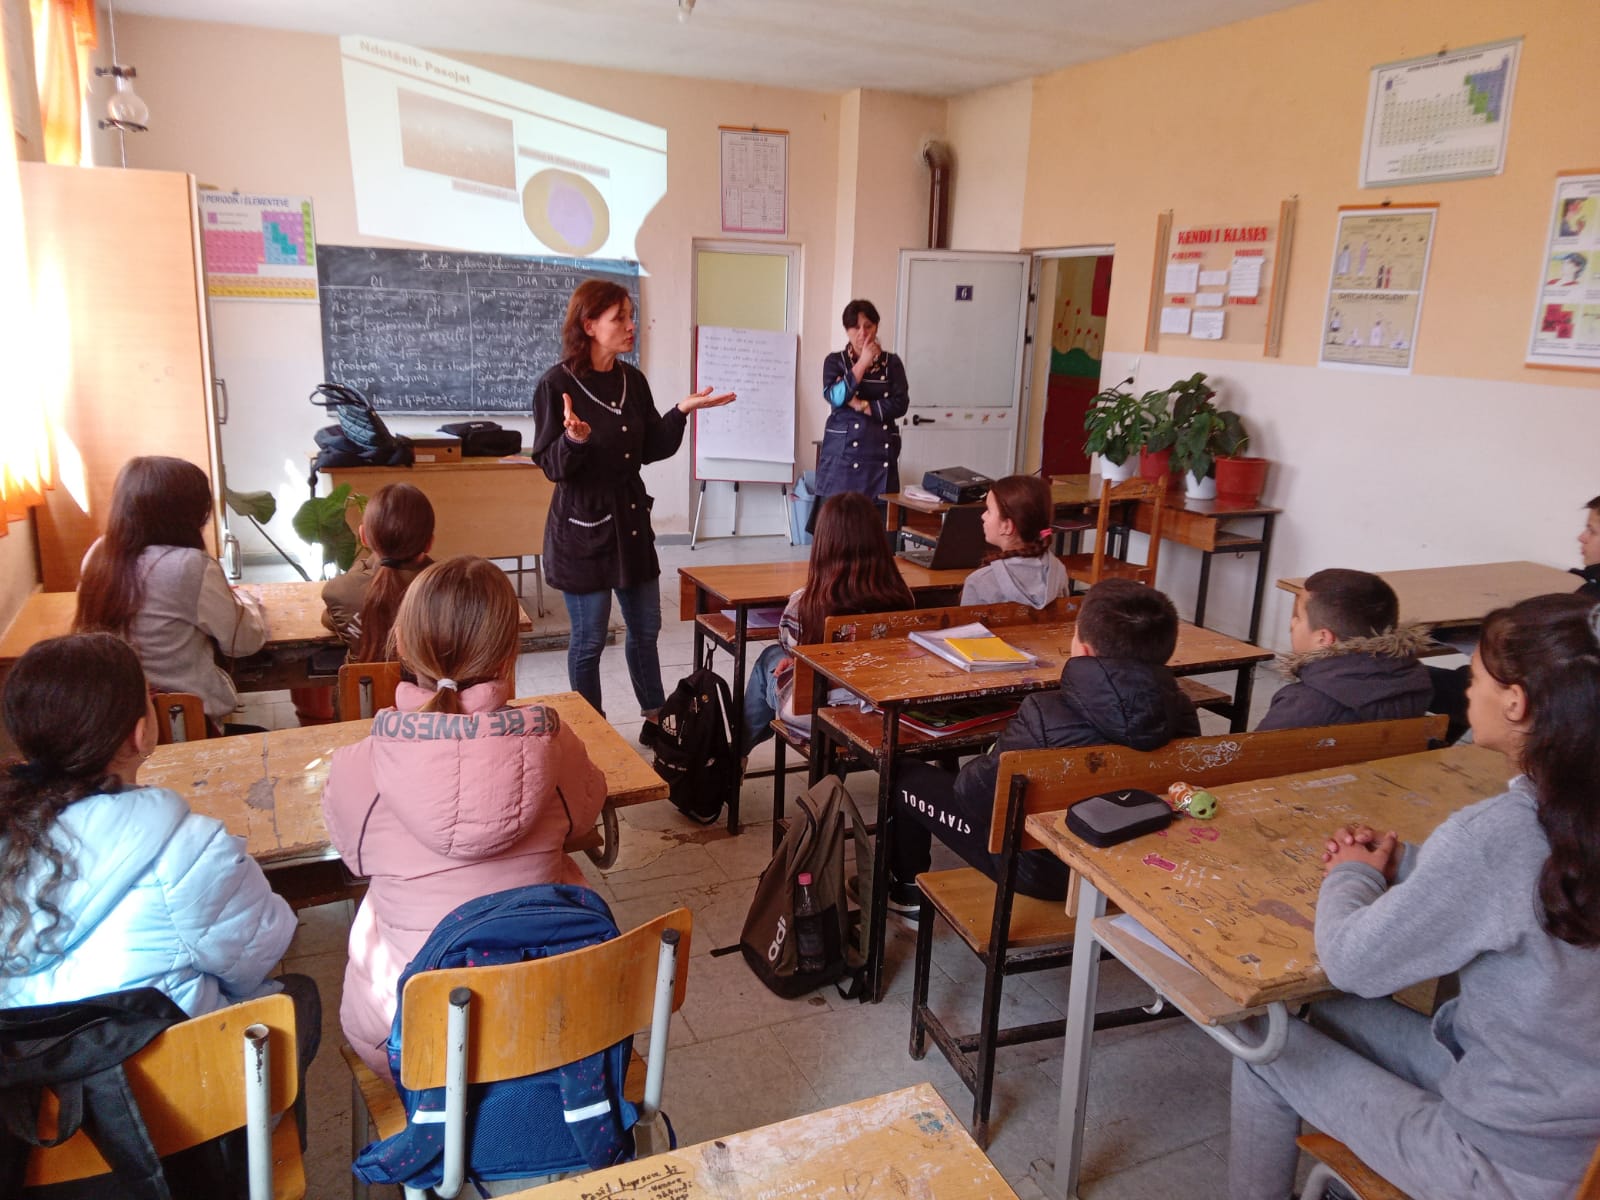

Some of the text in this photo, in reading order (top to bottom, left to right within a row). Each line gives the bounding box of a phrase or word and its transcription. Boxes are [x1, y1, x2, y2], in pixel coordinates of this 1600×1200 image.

[961, 286, 968, 300] 6
[487, 709, 525, 737] BE
[901, 789, 971, 835] STAY COOL
